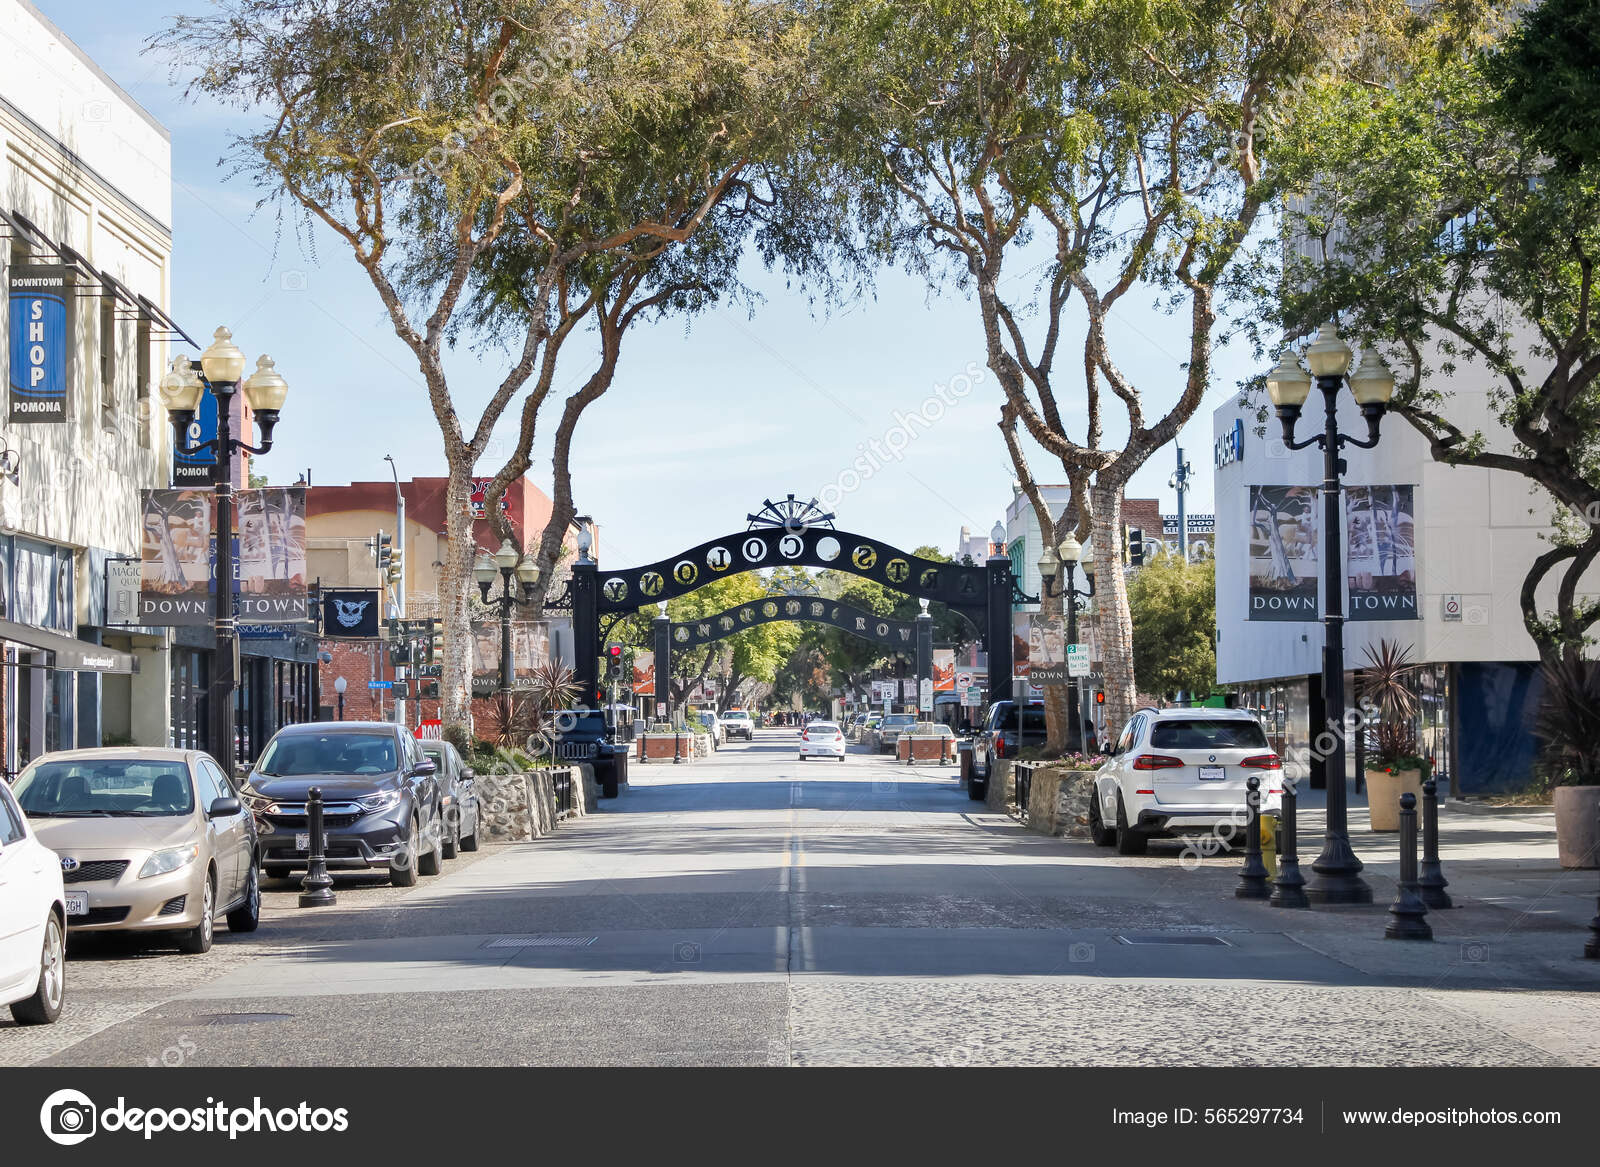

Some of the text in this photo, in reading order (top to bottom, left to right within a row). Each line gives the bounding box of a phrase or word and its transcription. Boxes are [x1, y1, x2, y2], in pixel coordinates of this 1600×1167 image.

[12, 278, 63, 287] DOWNTOWN
[29, 300, 45, 387] SHOP
[14, 402, 61, 413] POMONA
[176, 467, 208, 476] POMON
[144, 600, 206, 614] DOWN
[242, 599, 306, 613] TOWN
[1254, 595, 1415, 610] DOWN TOWN
[856, 617, 911, 641] ROW
